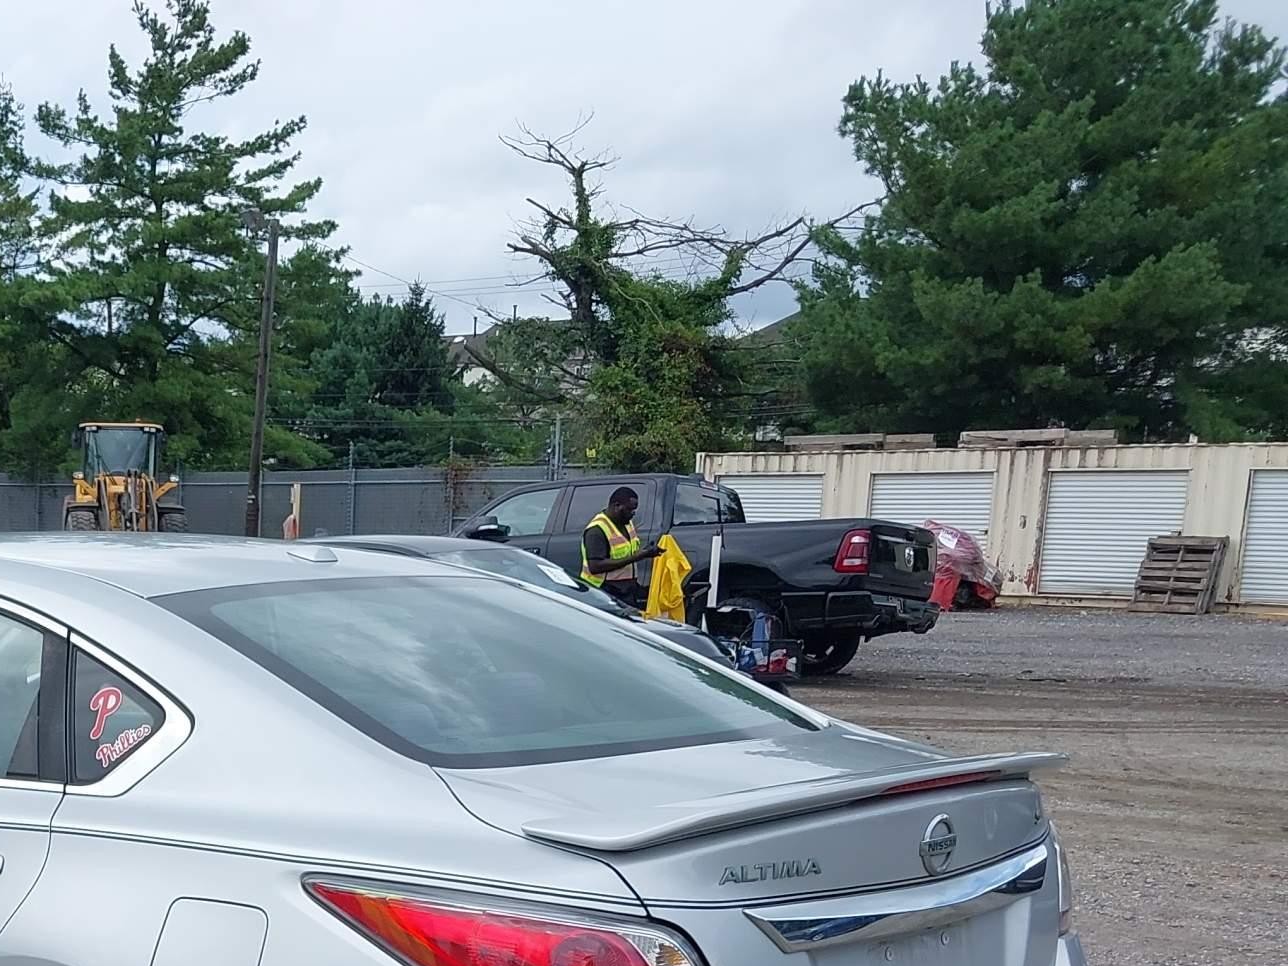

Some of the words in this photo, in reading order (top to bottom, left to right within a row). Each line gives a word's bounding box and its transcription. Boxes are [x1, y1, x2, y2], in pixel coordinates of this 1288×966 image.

[90, 687, 122, 739] P
[96, 725, 152, 767] Phillies
[927, 838, 956, 853] NISSAN
[719, 857, 822, 886] ALTIMA
